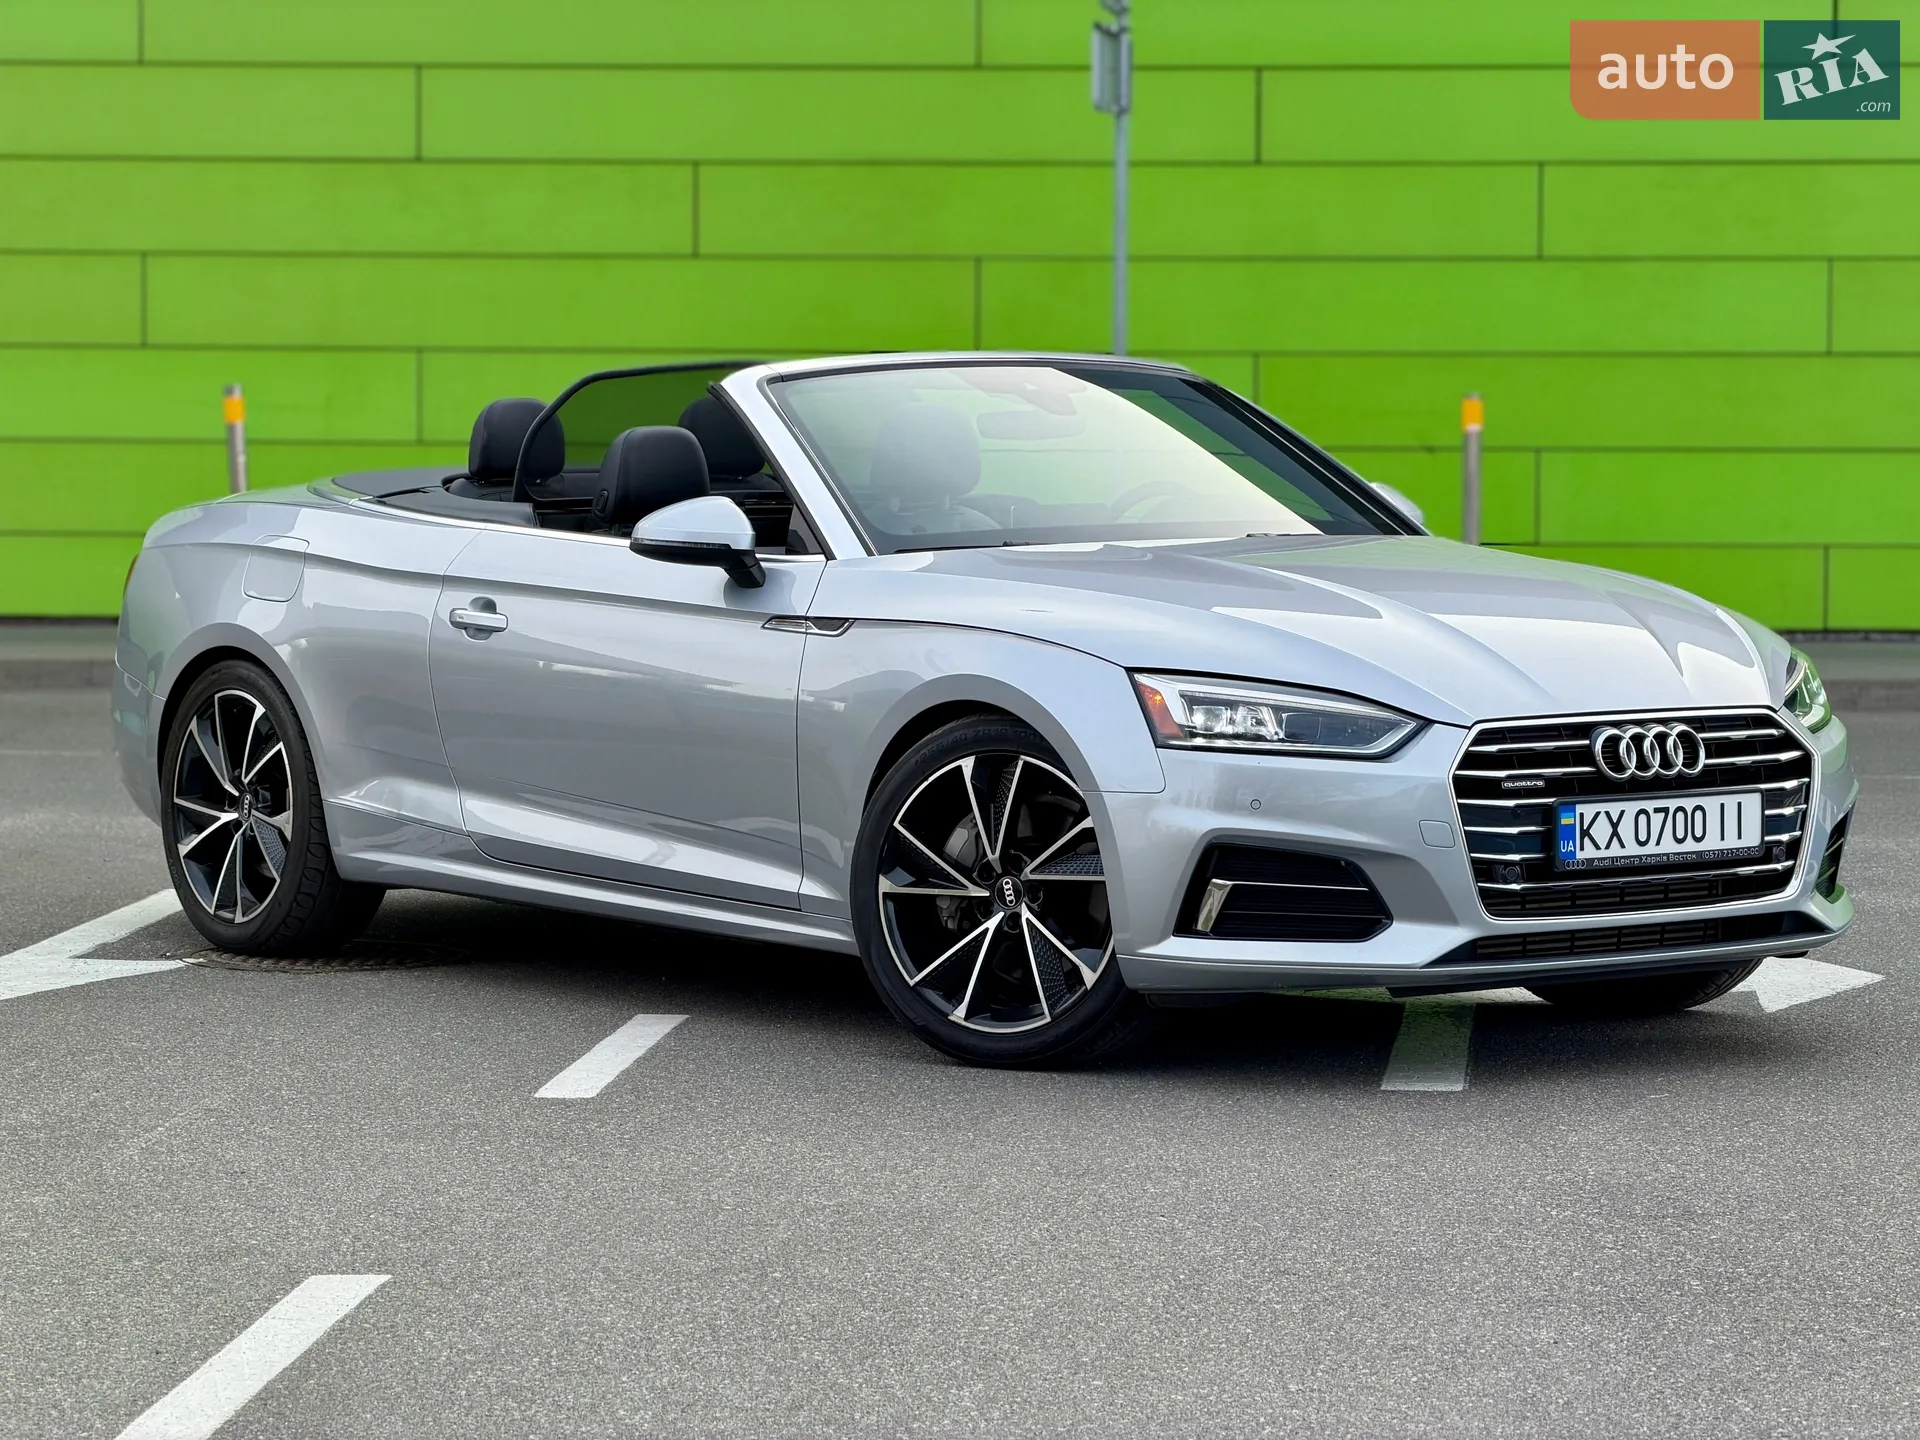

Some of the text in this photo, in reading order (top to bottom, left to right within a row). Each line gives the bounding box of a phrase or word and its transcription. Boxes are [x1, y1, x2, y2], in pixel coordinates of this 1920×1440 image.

[1579, 809, 1627, 852] KX
[1634, 804, 1707, 847] 0700
[1560, 840, 1575, 853] UA
[1593, 858, 1612, 867] Audi
[1613, 857, 1640, 866] Центр
[1701, 850, 1722, 860] (057)
